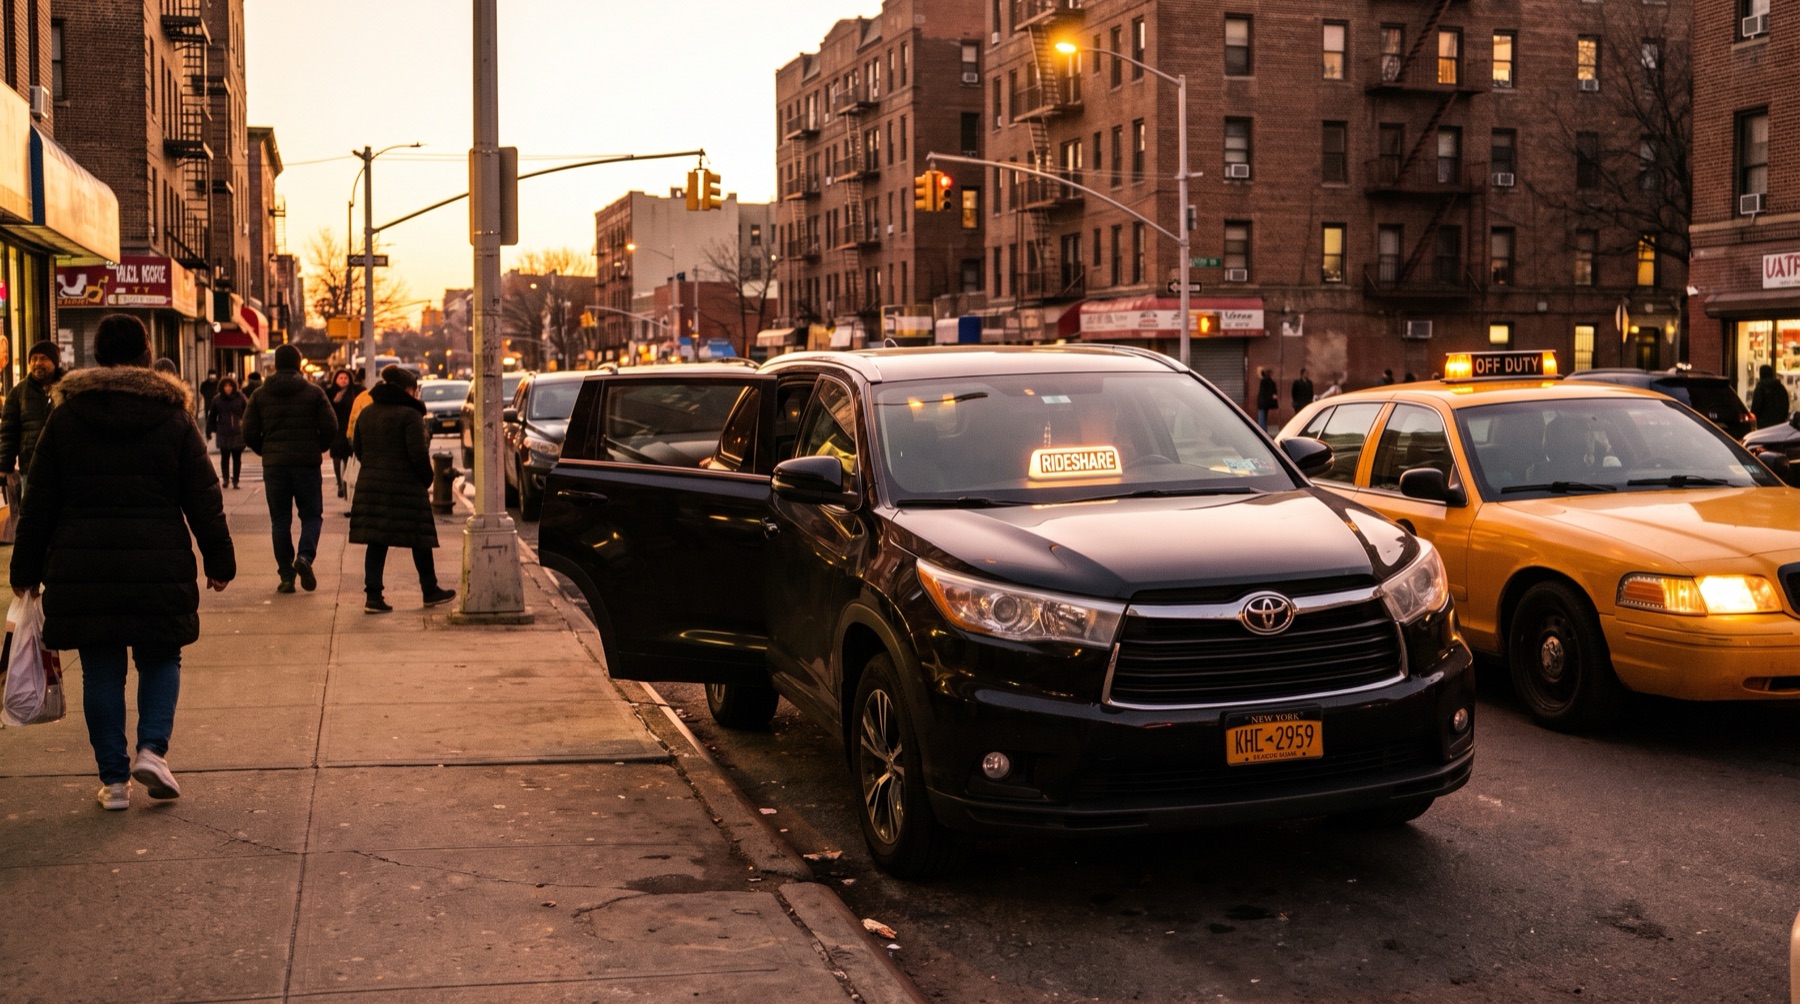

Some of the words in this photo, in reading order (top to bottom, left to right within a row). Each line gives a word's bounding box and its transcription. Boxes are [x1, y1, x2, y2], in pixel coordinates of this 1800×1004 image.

[1475, 358, 1500, 374] OFF
[1505, 356, 1539, 373] DUTY
[1041, 451, 1115, 473] RIDESHARE
[1251, 715, 1273, 724] NEW
[1276, 713, 1300, 721] YORK
[1275, 724, 1314, 750] 2959
